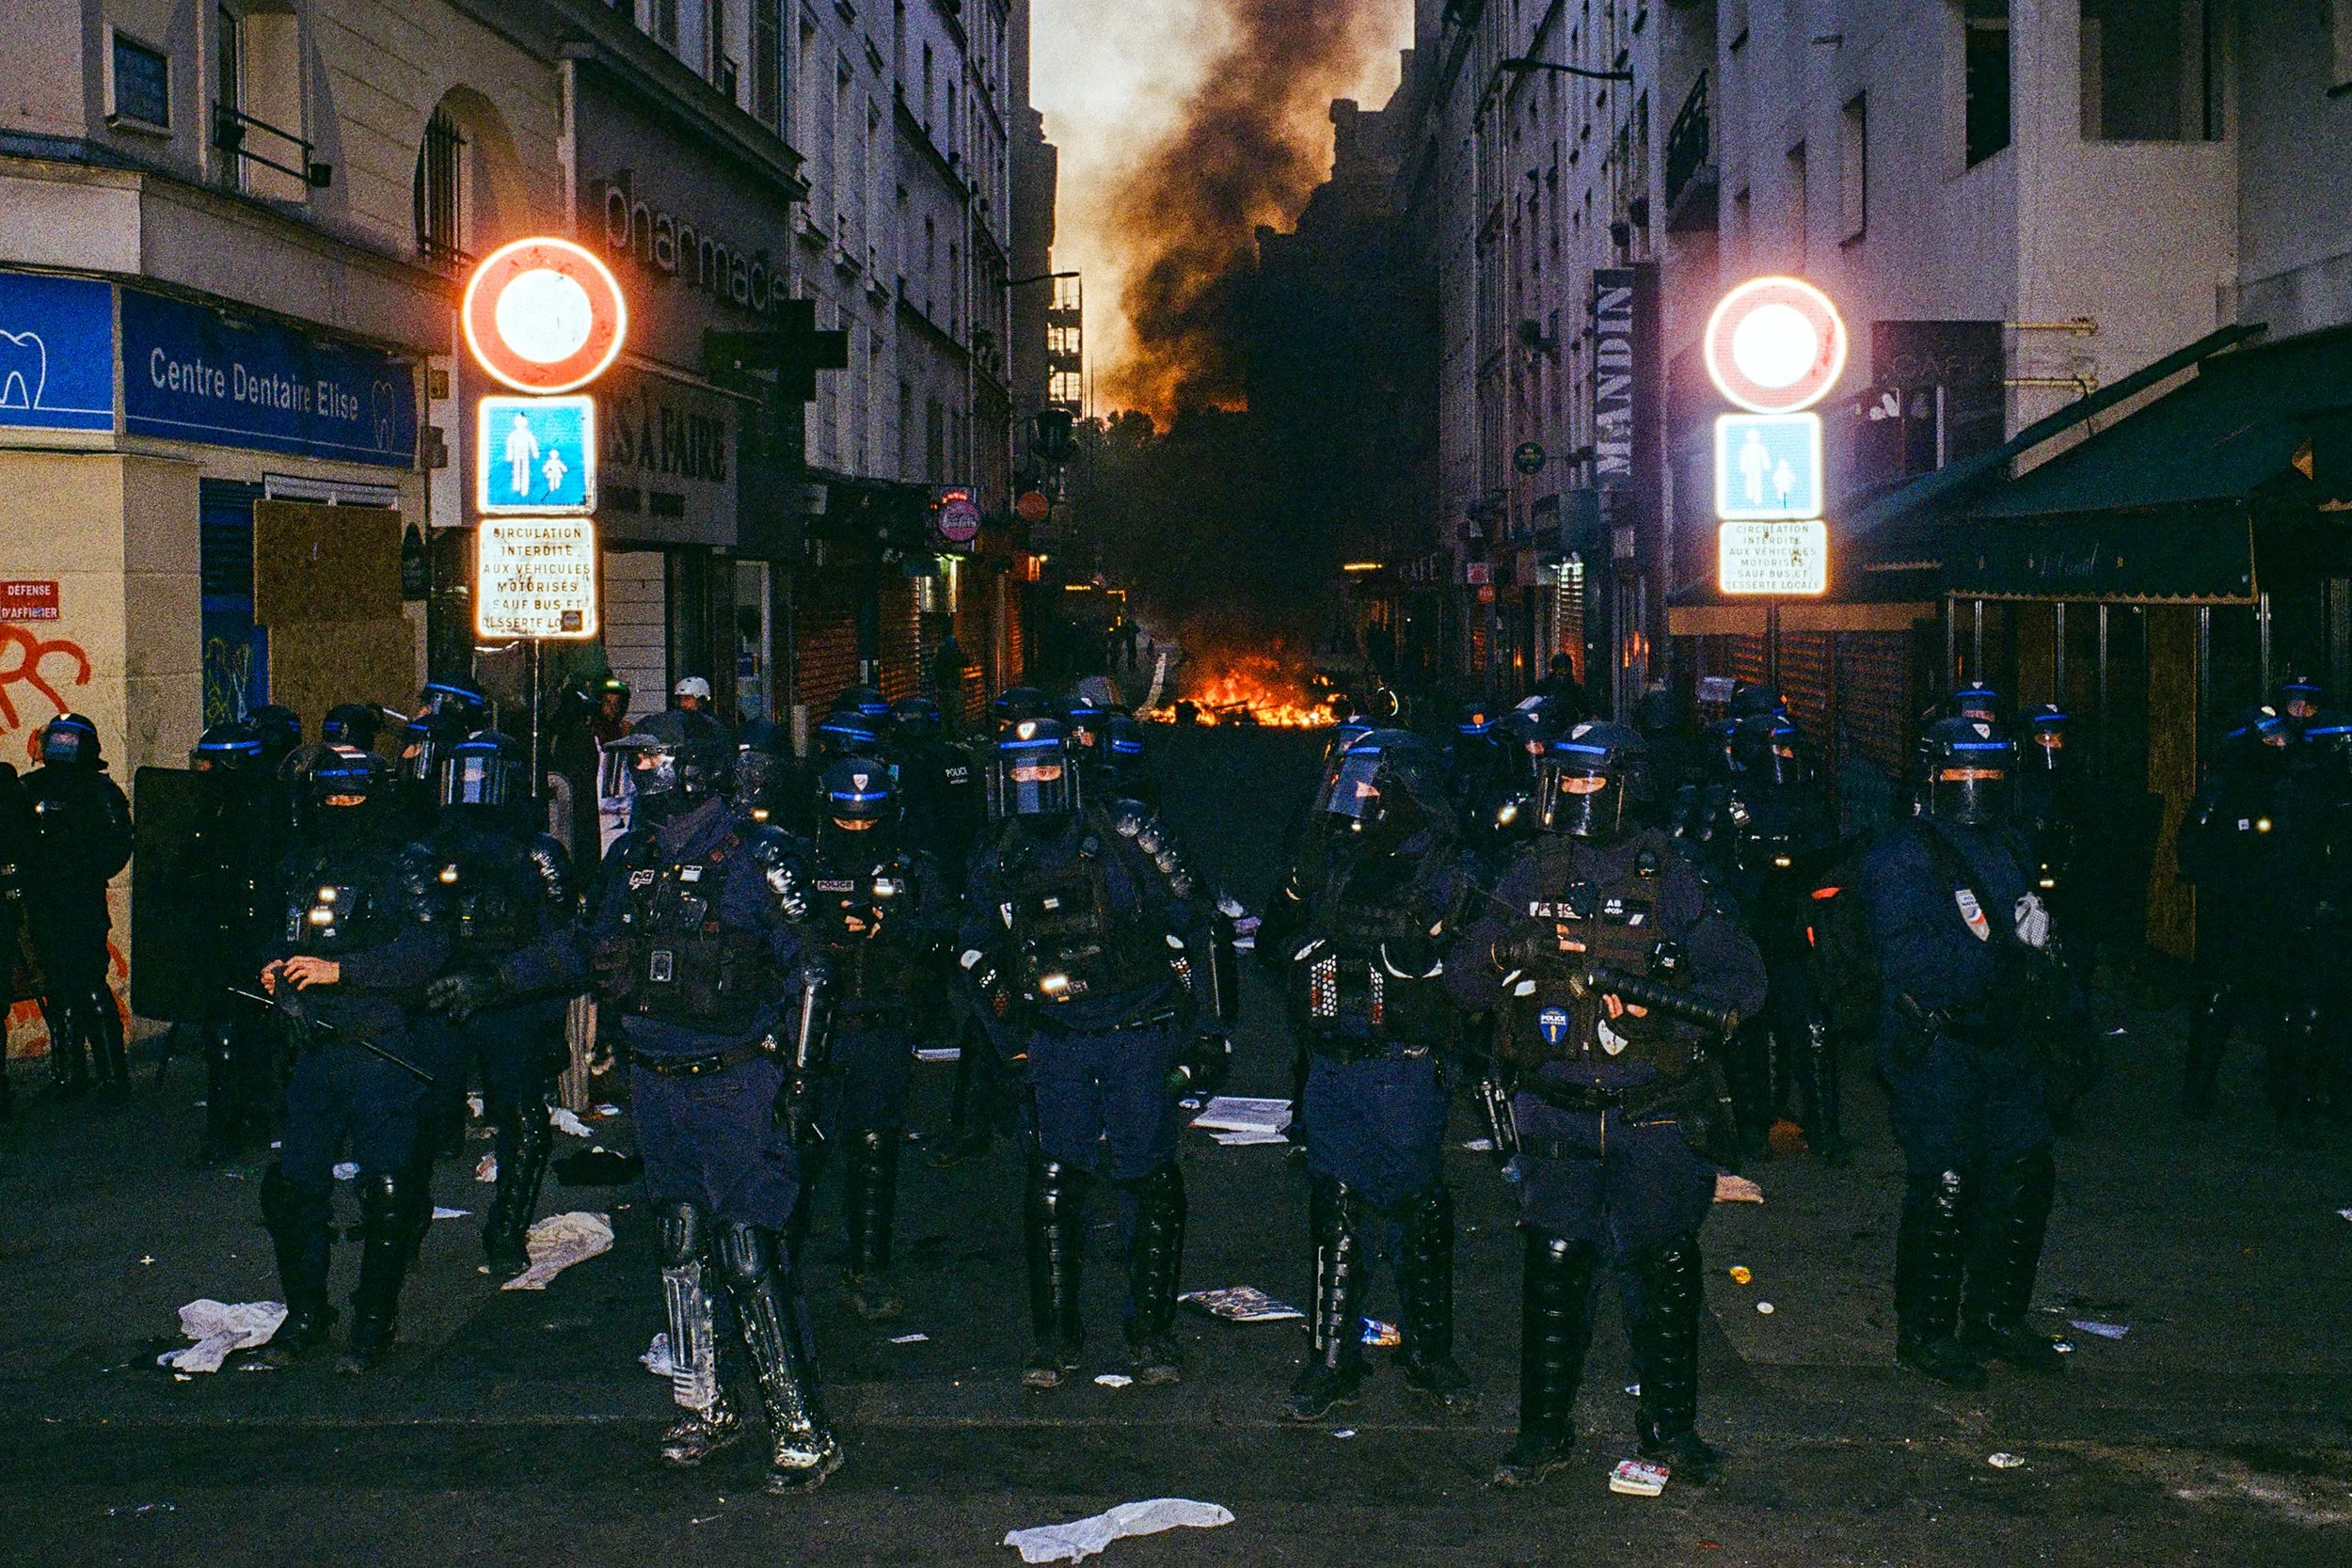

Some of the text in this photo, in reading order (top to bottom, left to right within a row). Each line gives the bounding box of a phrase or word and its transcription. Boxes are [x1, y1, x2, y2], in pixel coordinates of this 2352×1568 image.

[150, 346, 358, 421] Centre Dentaire Elise
[1596, 284, 1633, 477] MANDIN
[501, 545, 573, 556] INTERDITE
[484, 562, 590, 575] AUX VÉHICULES
[8, 583, 51, 596] DÉFENSE
[1725, 581, 1821, 590] DESSERTE LOCALE
[493, 599, 529, 610] SAUF
[533, 599, 562, 610] BUS
[1606, 899, 1622, 908] AB
